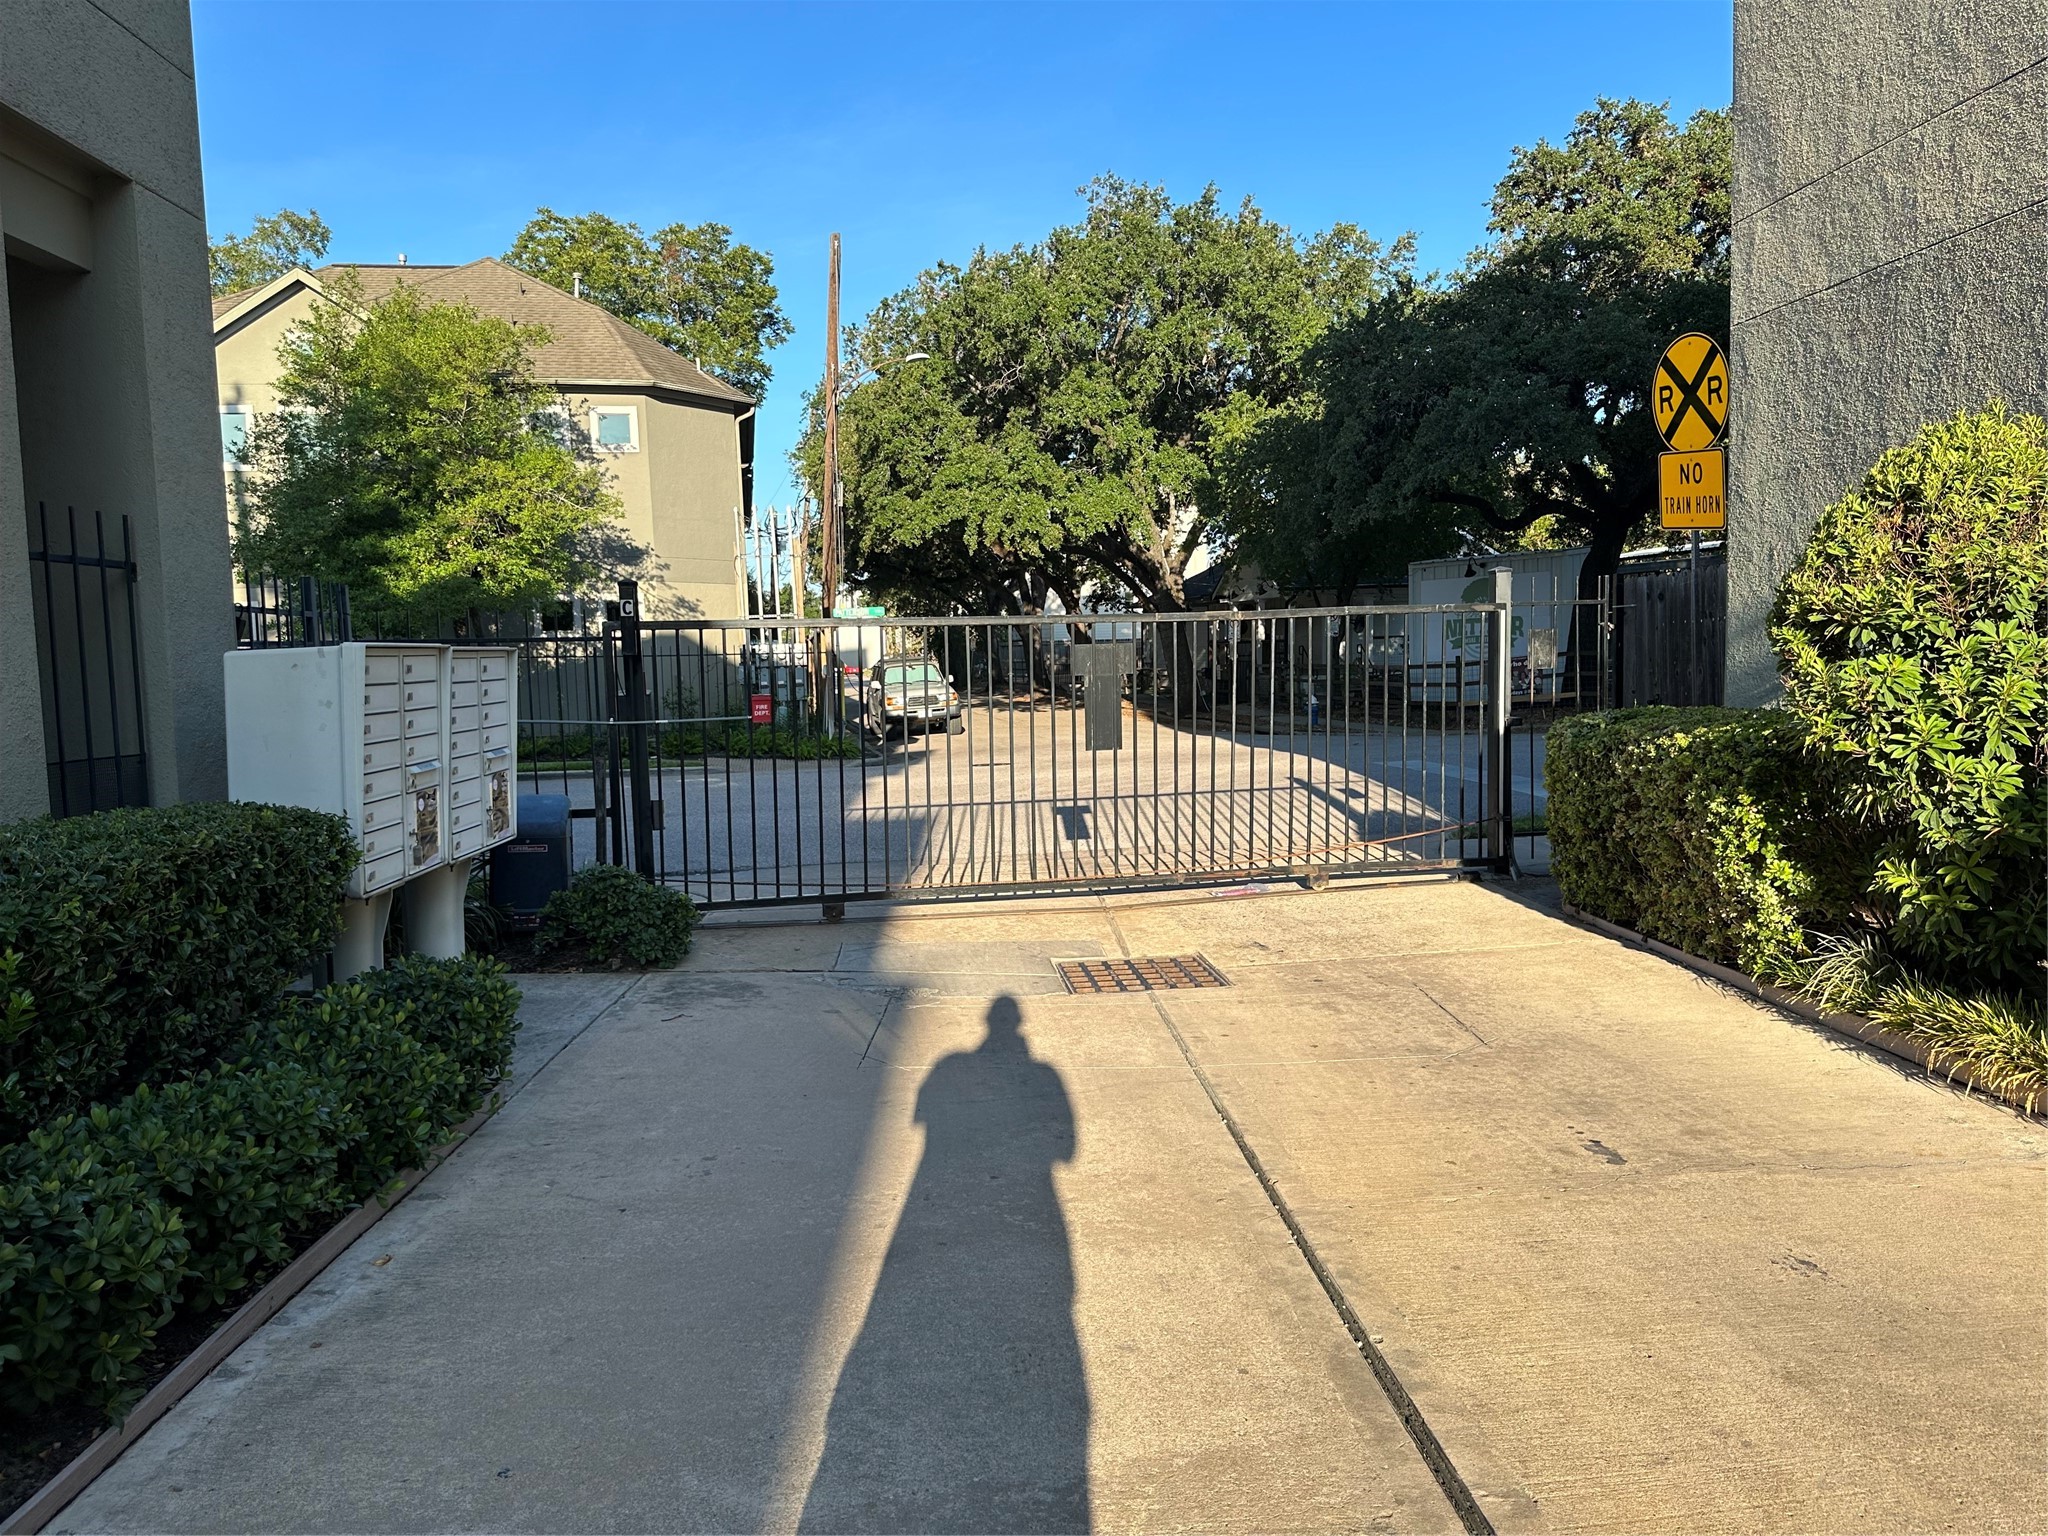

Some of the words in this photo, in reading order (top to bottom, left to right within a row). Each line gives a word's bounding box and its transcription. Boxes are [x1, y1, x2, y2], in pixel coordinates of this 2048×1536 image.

[1659, 385, 1674, 414] R
[1707, 375, 1723, 406] R
[1680, 462, 1703, 485] NO
[1664, 496, 1691, 514] TRAIN
[1695, 495, 1721, 514] HORN
[622, 600, 632, 615] C
